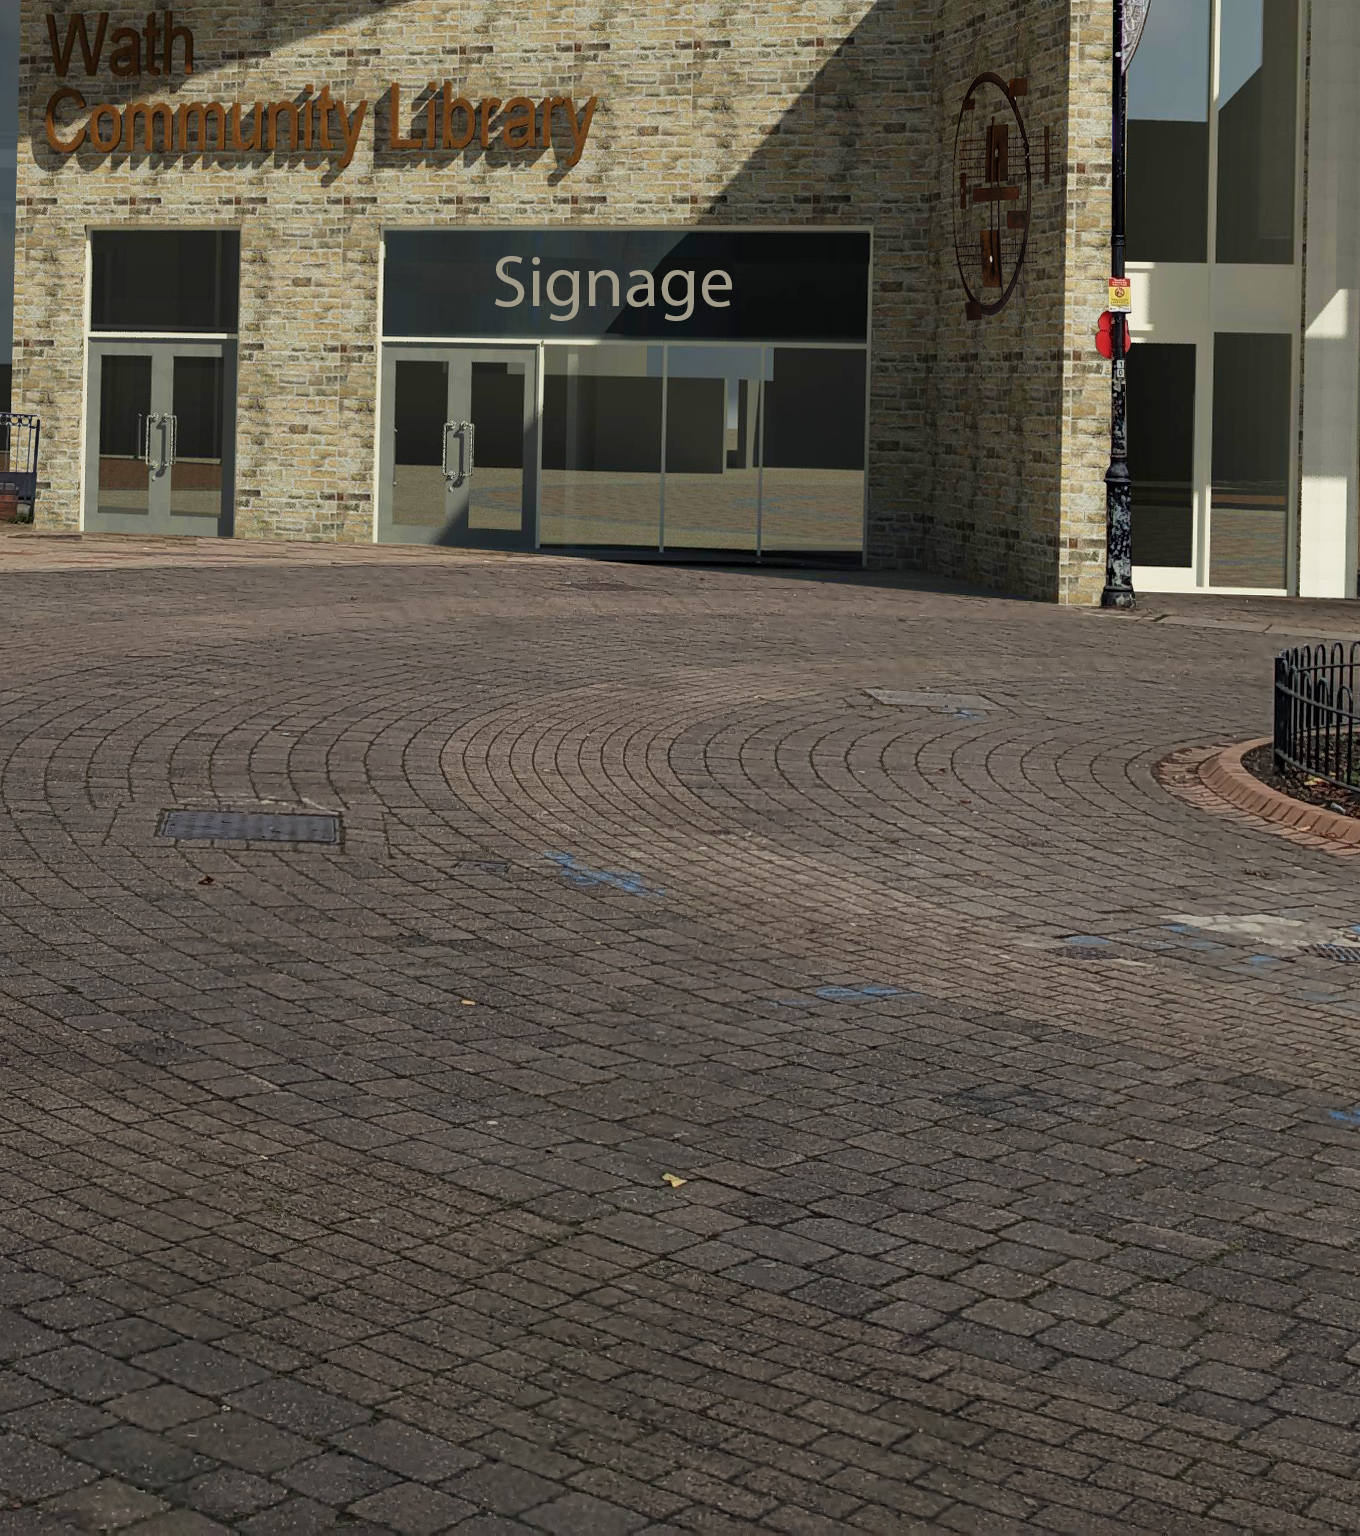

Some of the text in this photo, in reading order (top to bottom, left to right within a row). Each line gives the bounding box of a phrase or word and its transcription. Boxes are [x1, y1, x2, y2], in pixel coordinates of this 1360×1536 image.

[45, 10, 194, 79] Wath
[44, 81, 598, 167] Community Library
[494, 255, 733, 322] Signage
